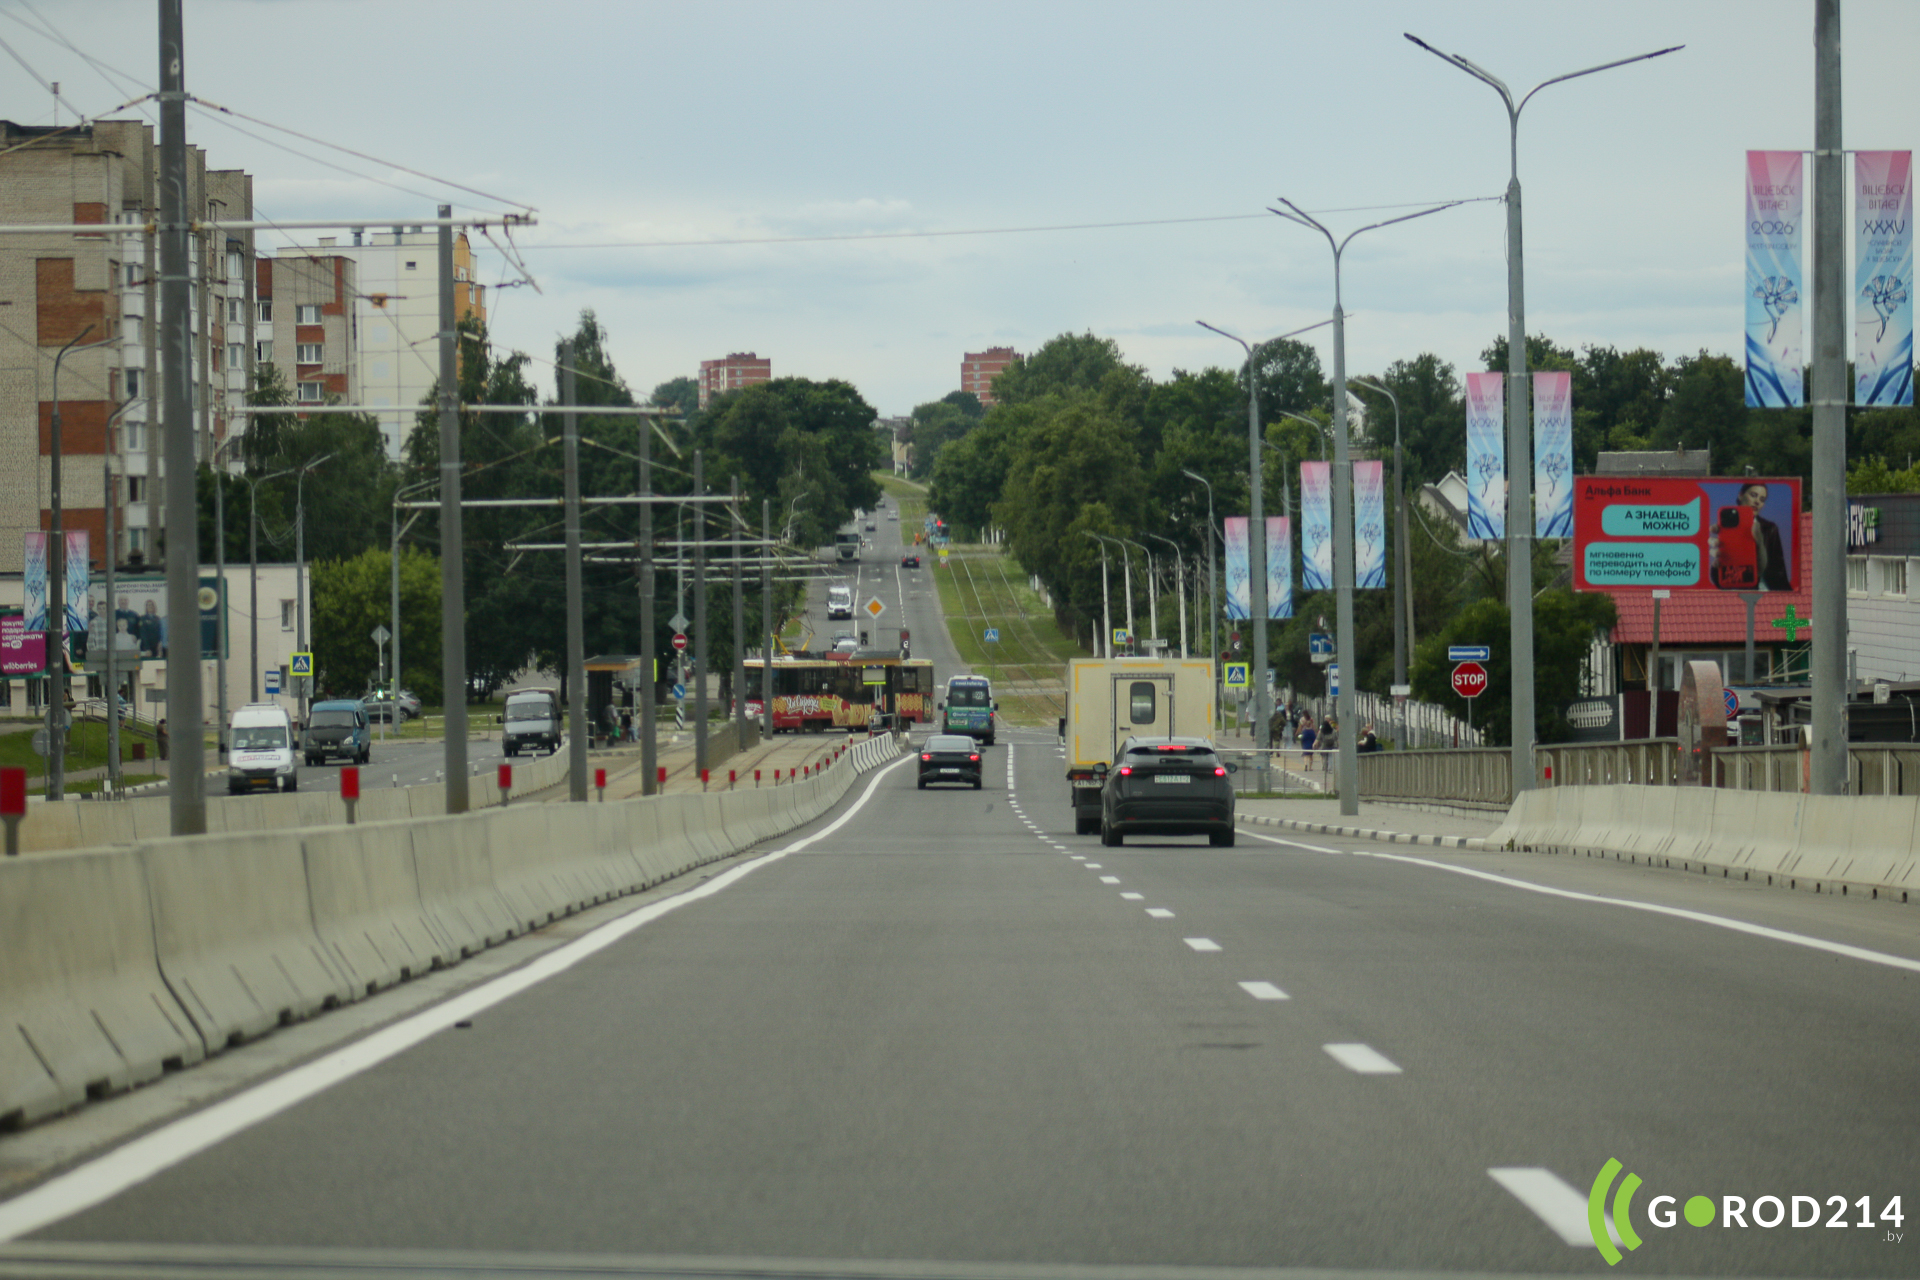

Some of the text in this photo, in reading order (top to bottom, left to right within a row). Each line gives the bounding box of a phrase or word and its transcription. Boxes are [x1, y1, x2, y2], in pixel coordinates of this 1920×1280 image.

[1751, 220, 1794, 235] 2026
[1862, 219, 1905, 235] XXXV
[1470, 417, 1498, 428] 2026
[1585, 485, 1651, 498] Альфа Банк
[1625, 510, 1690, 521] А ЗНАЕШЬ,
[1642, 521, 1690, 531] МОЖНО
[1589, 551, 1644, 559] мгновенно
[1589, 559, 1696, 569] переводить на Альфу
[1603, 569, 1641, 578] номеру
[1643, 568, 1691, 578] телефона
[2, 633, 44, 641] сертификаты
[3, 661, 38, 670] wildberries
[1454, 673, 1485, 686] STOP
